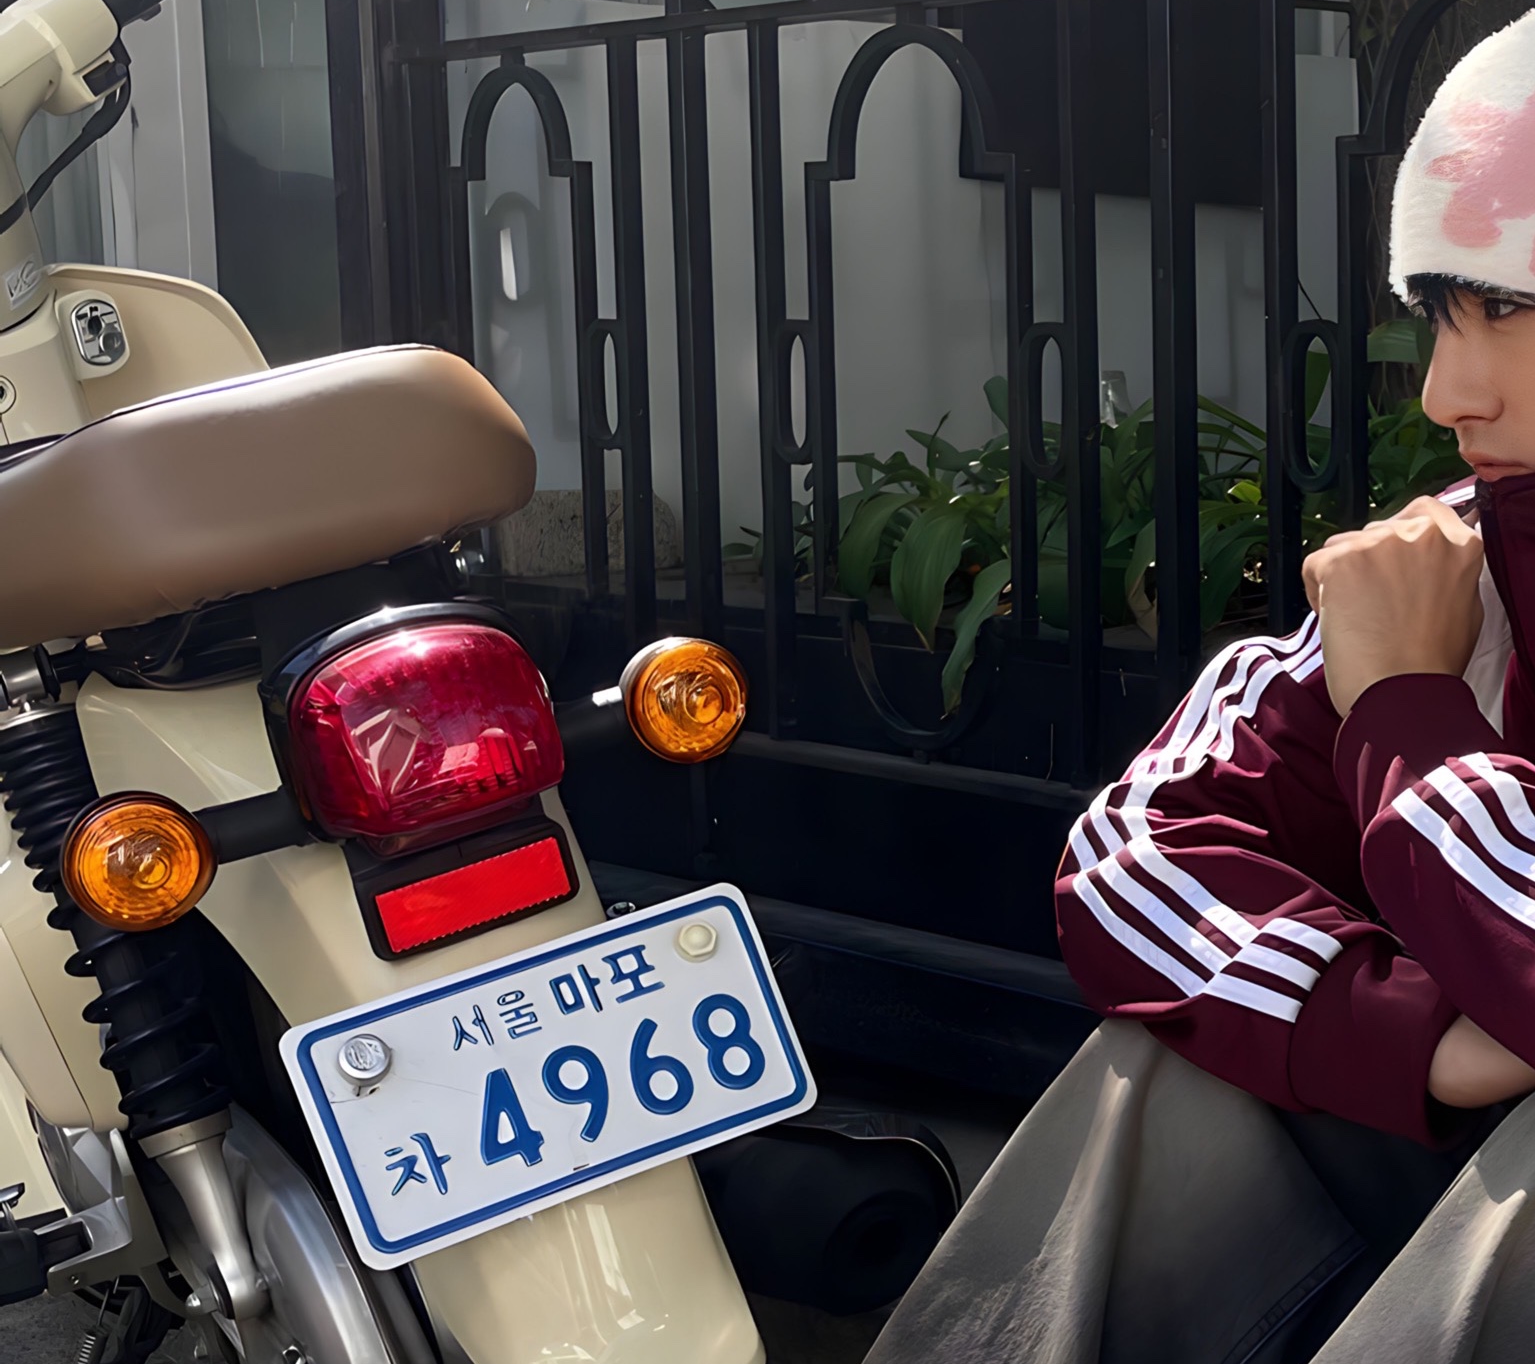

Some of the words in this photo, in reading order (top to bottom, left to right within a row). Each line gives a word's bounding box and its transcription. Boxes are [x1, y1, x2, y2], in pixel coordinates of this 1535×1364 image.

[453, 990, 542, 1051] 서울
[549, 945, 666, 1015] 마포
[384, 1132, 451, 1197] 차
[480, 993, 766, 1167] 4968
